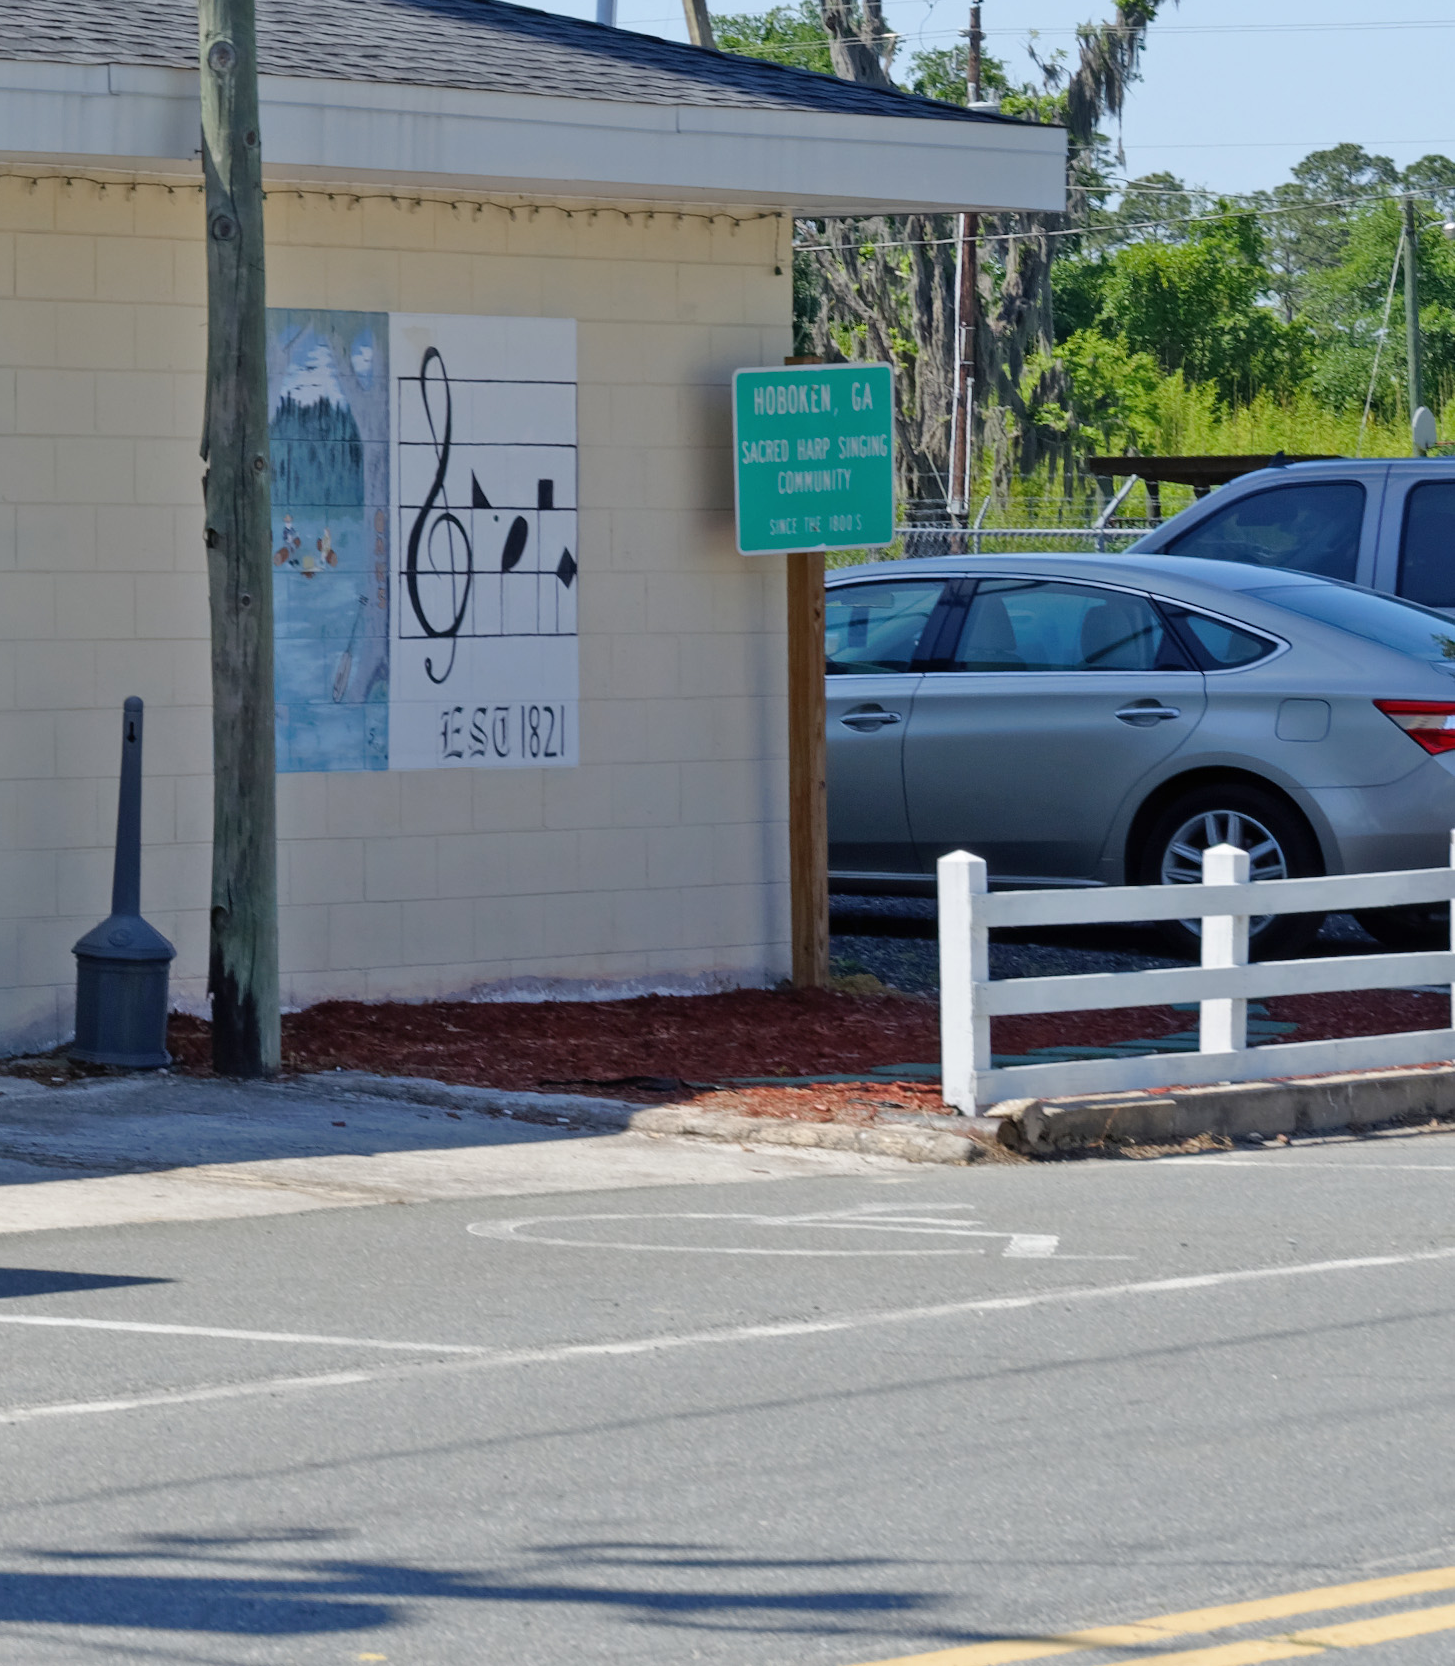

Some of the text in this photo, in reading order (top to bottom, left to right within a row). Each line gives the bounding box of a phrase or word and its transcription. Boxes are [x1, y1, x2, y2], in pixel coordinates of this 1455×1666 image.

[753, 381, 874, 417] HOBOKEN, GA
[741, 433, 888, 465] SACRED HARP SINGING
[777, 468, 852, 495] COMMUNITY
[769, 517, 797, 536] SINCE
[803, 515, 822, 534] THE
[521, 705, 565, 759] 1821
